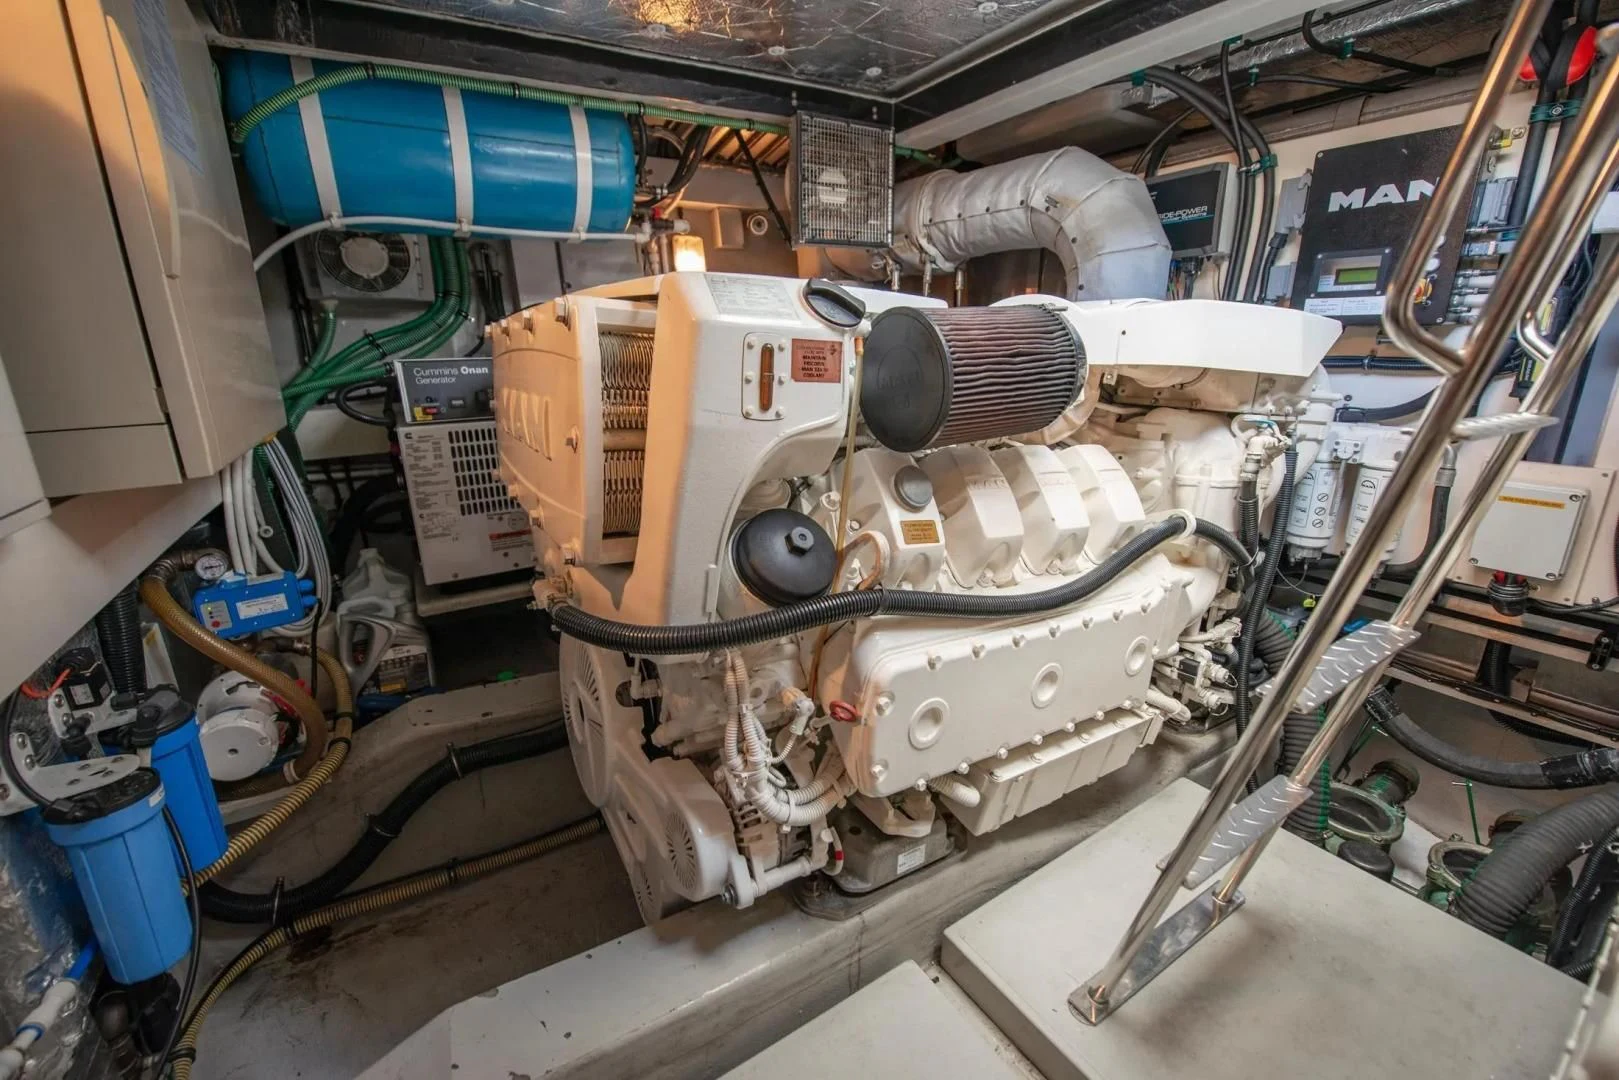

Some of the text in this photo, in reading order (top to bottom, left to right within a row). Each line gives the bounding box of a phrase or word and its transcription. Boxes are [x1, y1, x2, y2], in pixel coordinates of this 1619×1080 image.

[1328, 177, 1440, 212] MAN
[413, 366, 489, 376] Cummins Onan
[415, 376, 457, 385] Generator
